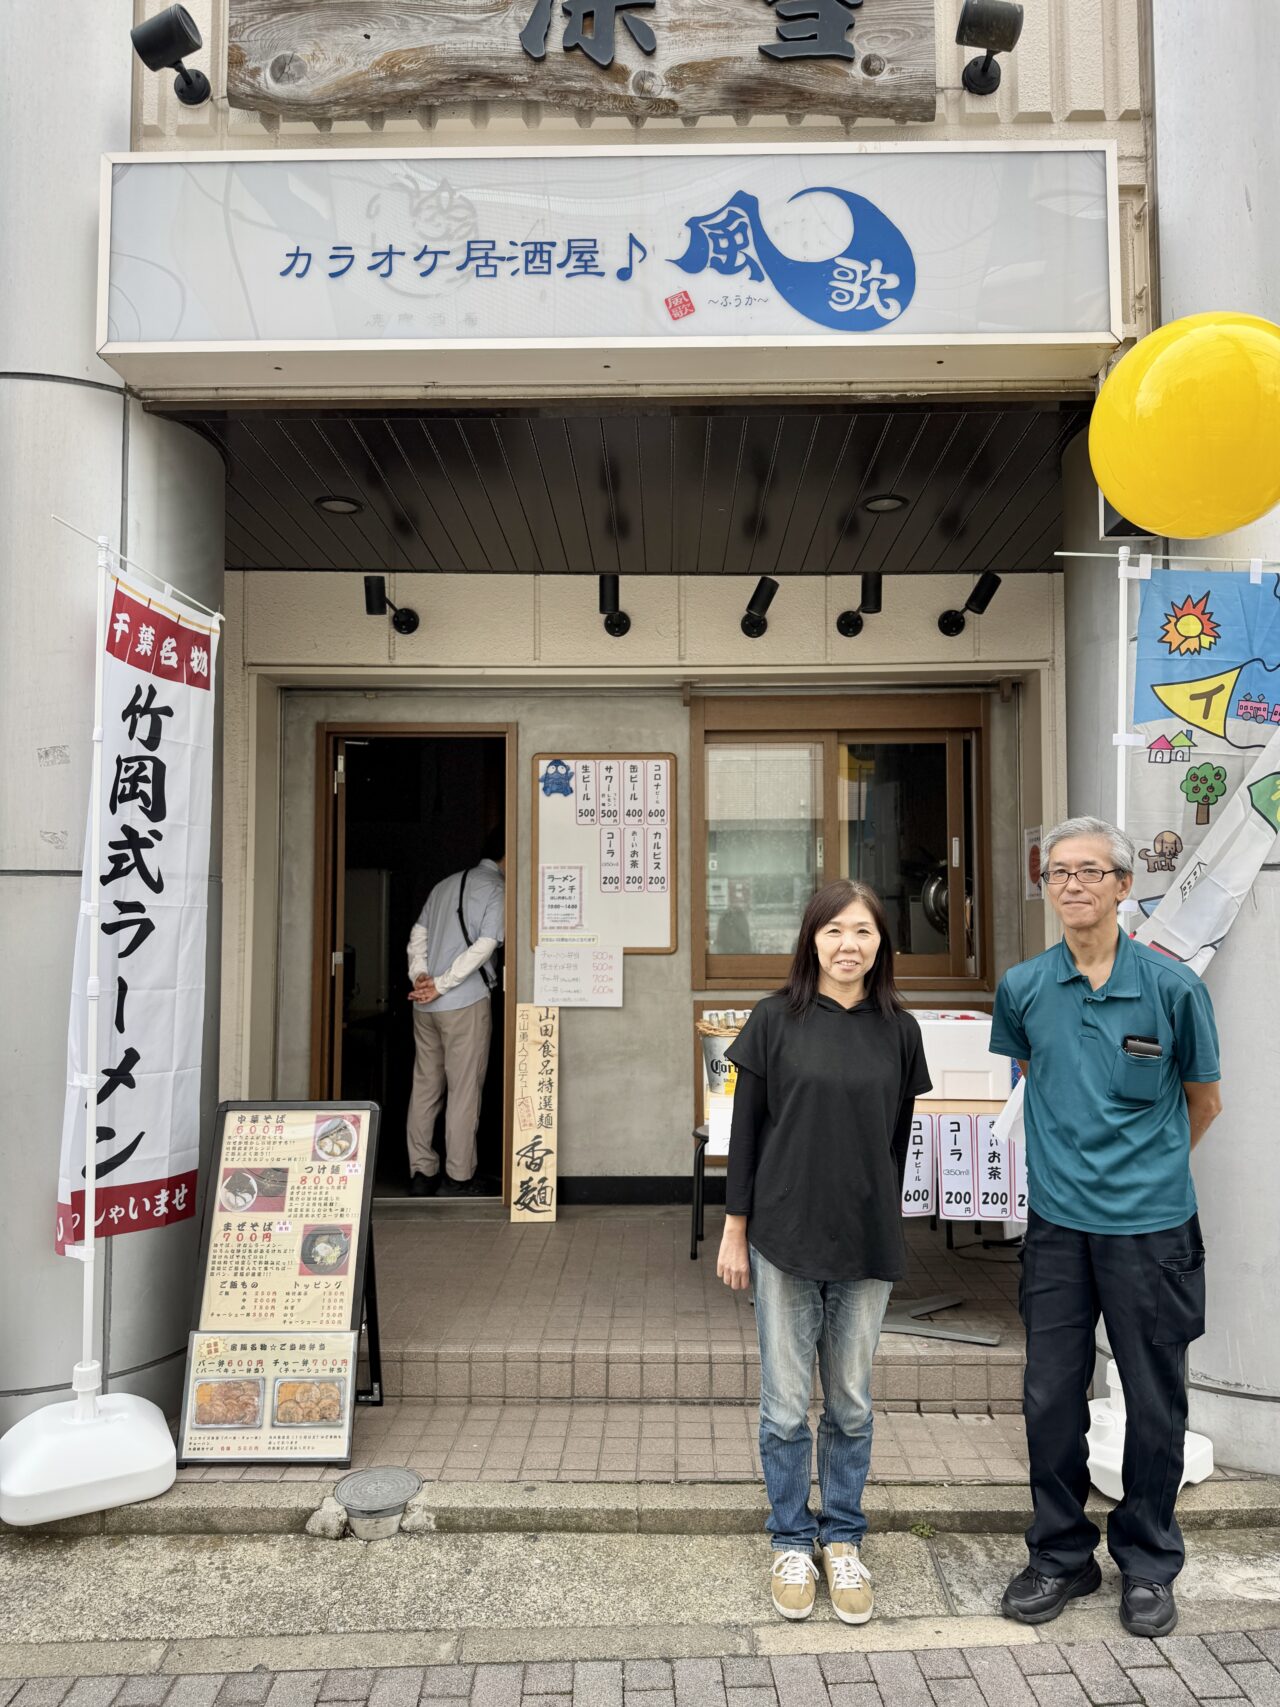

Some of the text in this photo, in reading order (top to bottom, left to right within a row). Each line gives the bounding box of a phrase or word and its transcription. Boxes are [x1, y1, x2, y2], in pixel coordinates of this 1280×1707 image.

[112, 612, 209, 678] 千葉名物
[581, 764, 591, 801] 生ビール
[604, 764, 614, 792] サワー
[629, 764, 639, 801] 缶ビール
[578, 808, 595, 818] 500
[601, 809, 618, 818] 500
[625, 808, 643, 818] 400
[648, 808, 665, 818] 600
[606, 832, 615, 858] コーラ
[630, 830, 639, 869] おーいお茶
[602, 876, 620, 885] 200
[625, 875, 643, 885] 200
[648, 876, 665, 885] 200
[547, 885, 576, 893] ランチ
[82, 683, 174, 1181] 竹岡式ラーメン
[237, 1114, 286, 1124] 中華そば
[236, 1125, 284, 1135] 600円
[949, 1121, 962, 1162] コーラ
[912, 1120, 924, 1181] コロナビール
[304, 1164, 341, 1174] つけ麺
[299, 1175, 348, 1185] 800円
[904, 1189, 929, 1202] 600
[945, 1191, 971, 1204] 200
[981, 1192, 1008, 1205] 200
[223, 1222, 273, 1232] まぜそば
[223, 1232, 272, 1242] 700円
[219, 1280, 259, 1289] ご飯もの
[294, 1280, 342, 1289] トッピング
